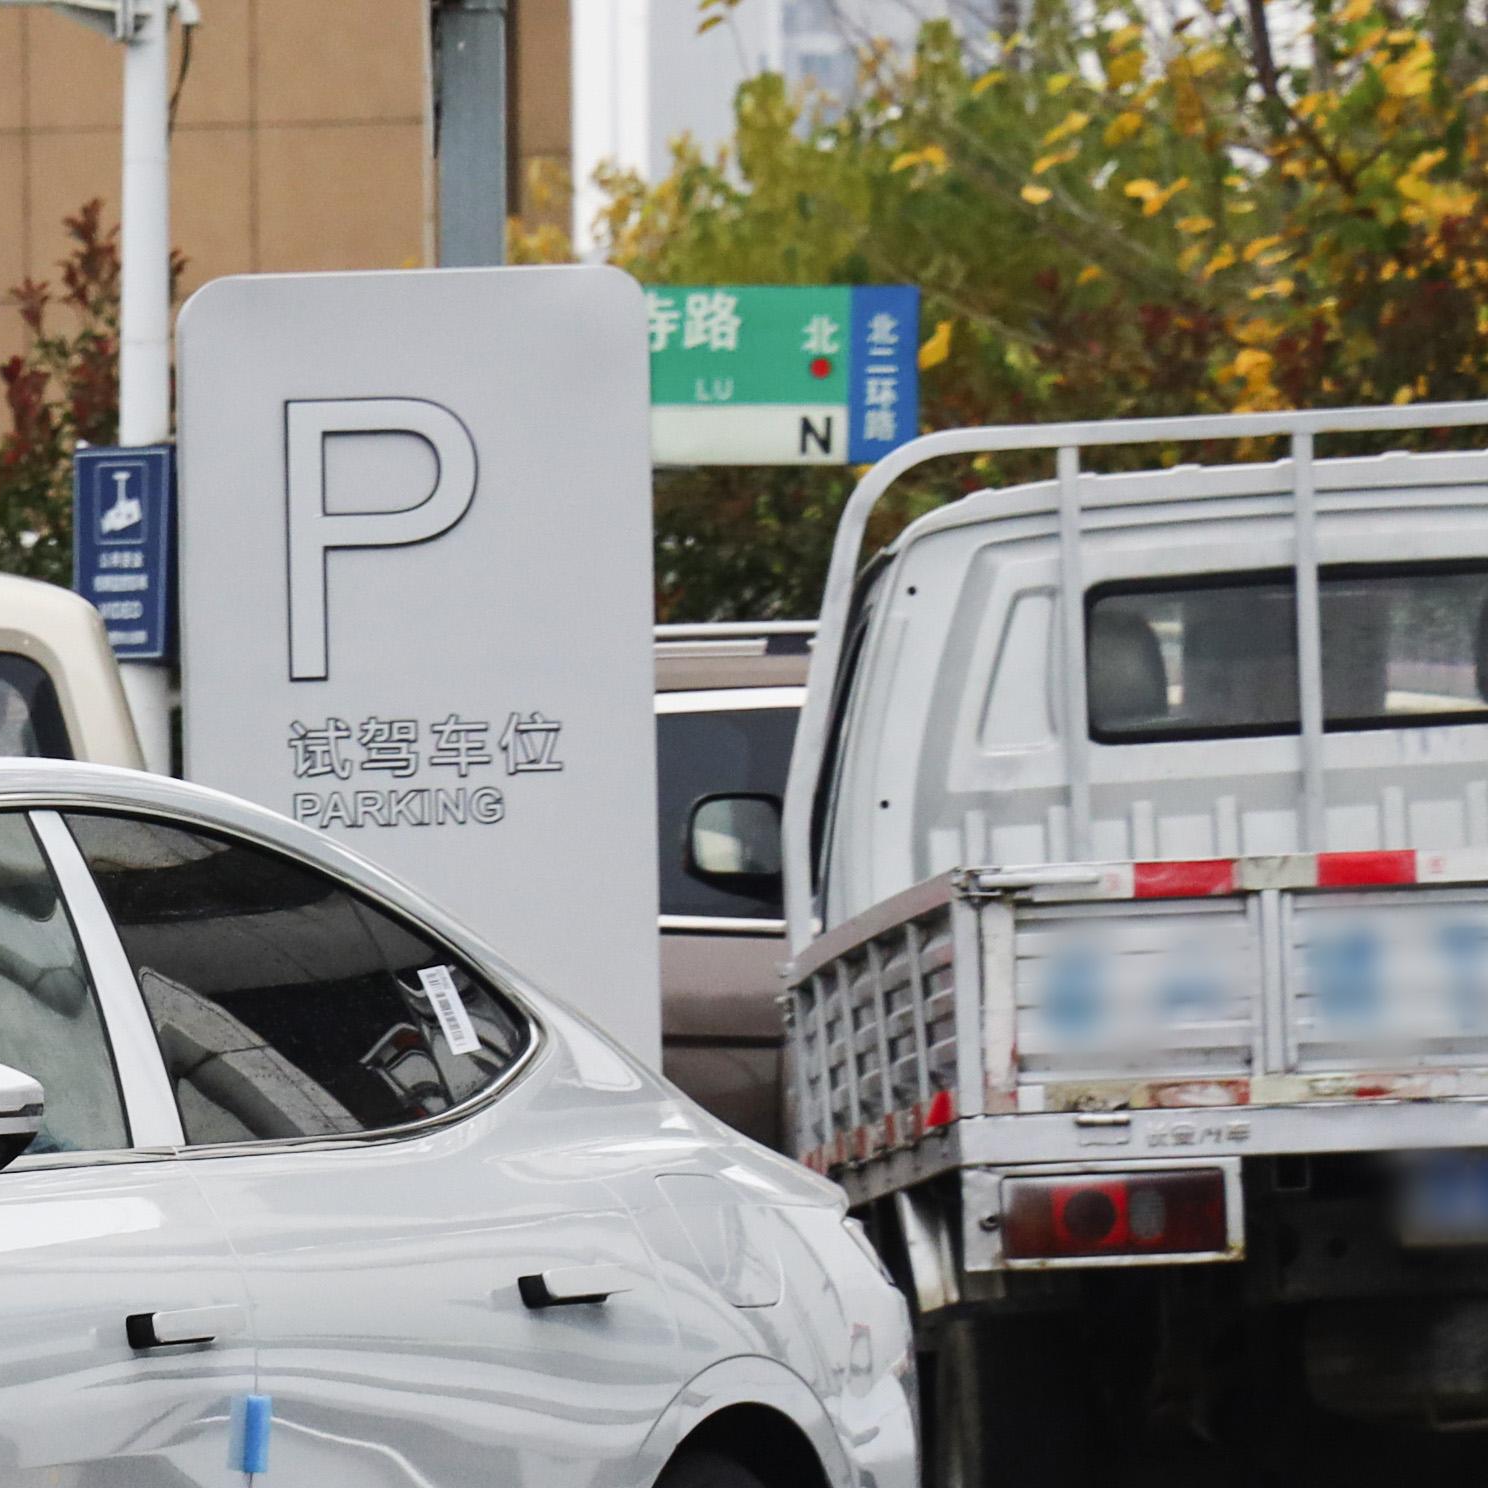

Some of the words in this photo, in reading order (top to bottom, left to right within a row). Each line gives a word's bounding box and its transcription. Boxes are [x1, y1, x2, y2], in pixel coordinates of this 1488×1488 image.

[801, 315, 840, 354] 北
[694, 378, 735, 402] LU
[800, 415, 833, 455] N
[284, 397, 479, 681] P
[288, 711, 564, 780] 试驾车位
[293, 786, 506, 829] PARKING
